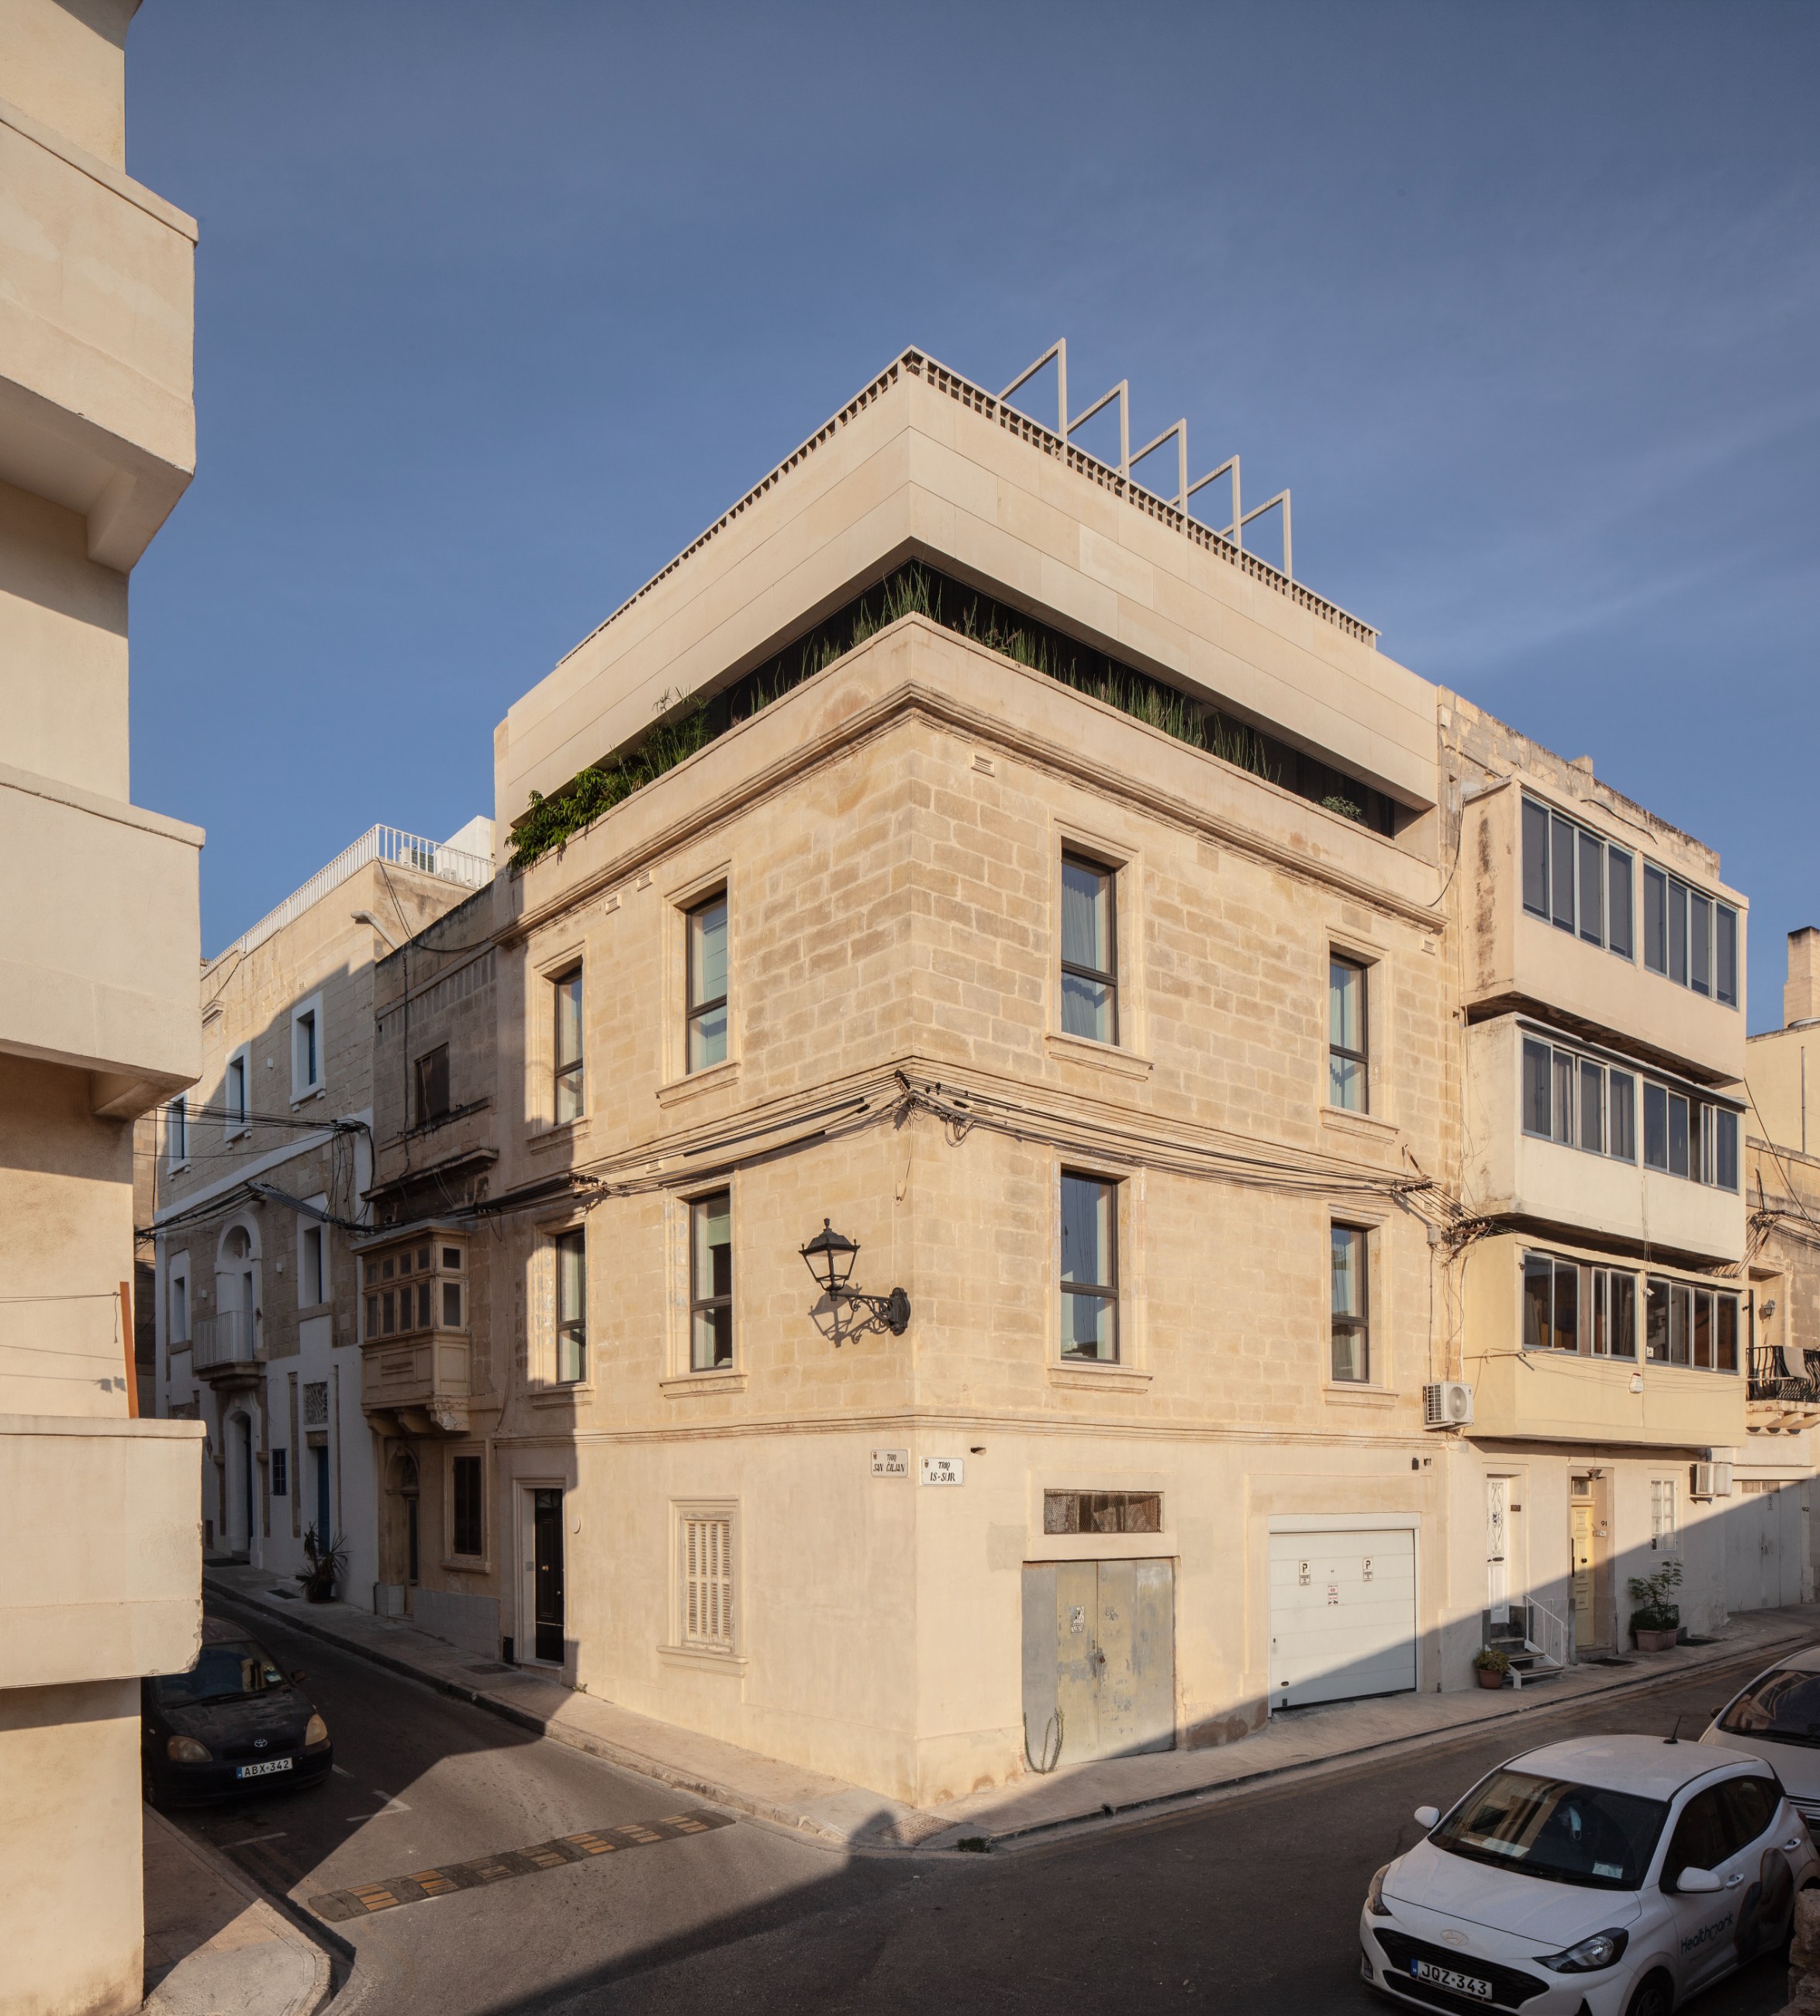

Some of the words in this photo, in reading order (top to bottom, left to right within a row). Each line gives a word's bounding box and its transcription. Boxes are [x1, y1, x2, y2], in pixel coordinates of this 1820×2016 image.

[873, 1463, 883, 1472] SAN
[938, 1462, 951, 1470] TRIQ
[930, 1472, 955, 1482] IS-SUR
[1680, 1911, 1734, 1955] Healthmark
